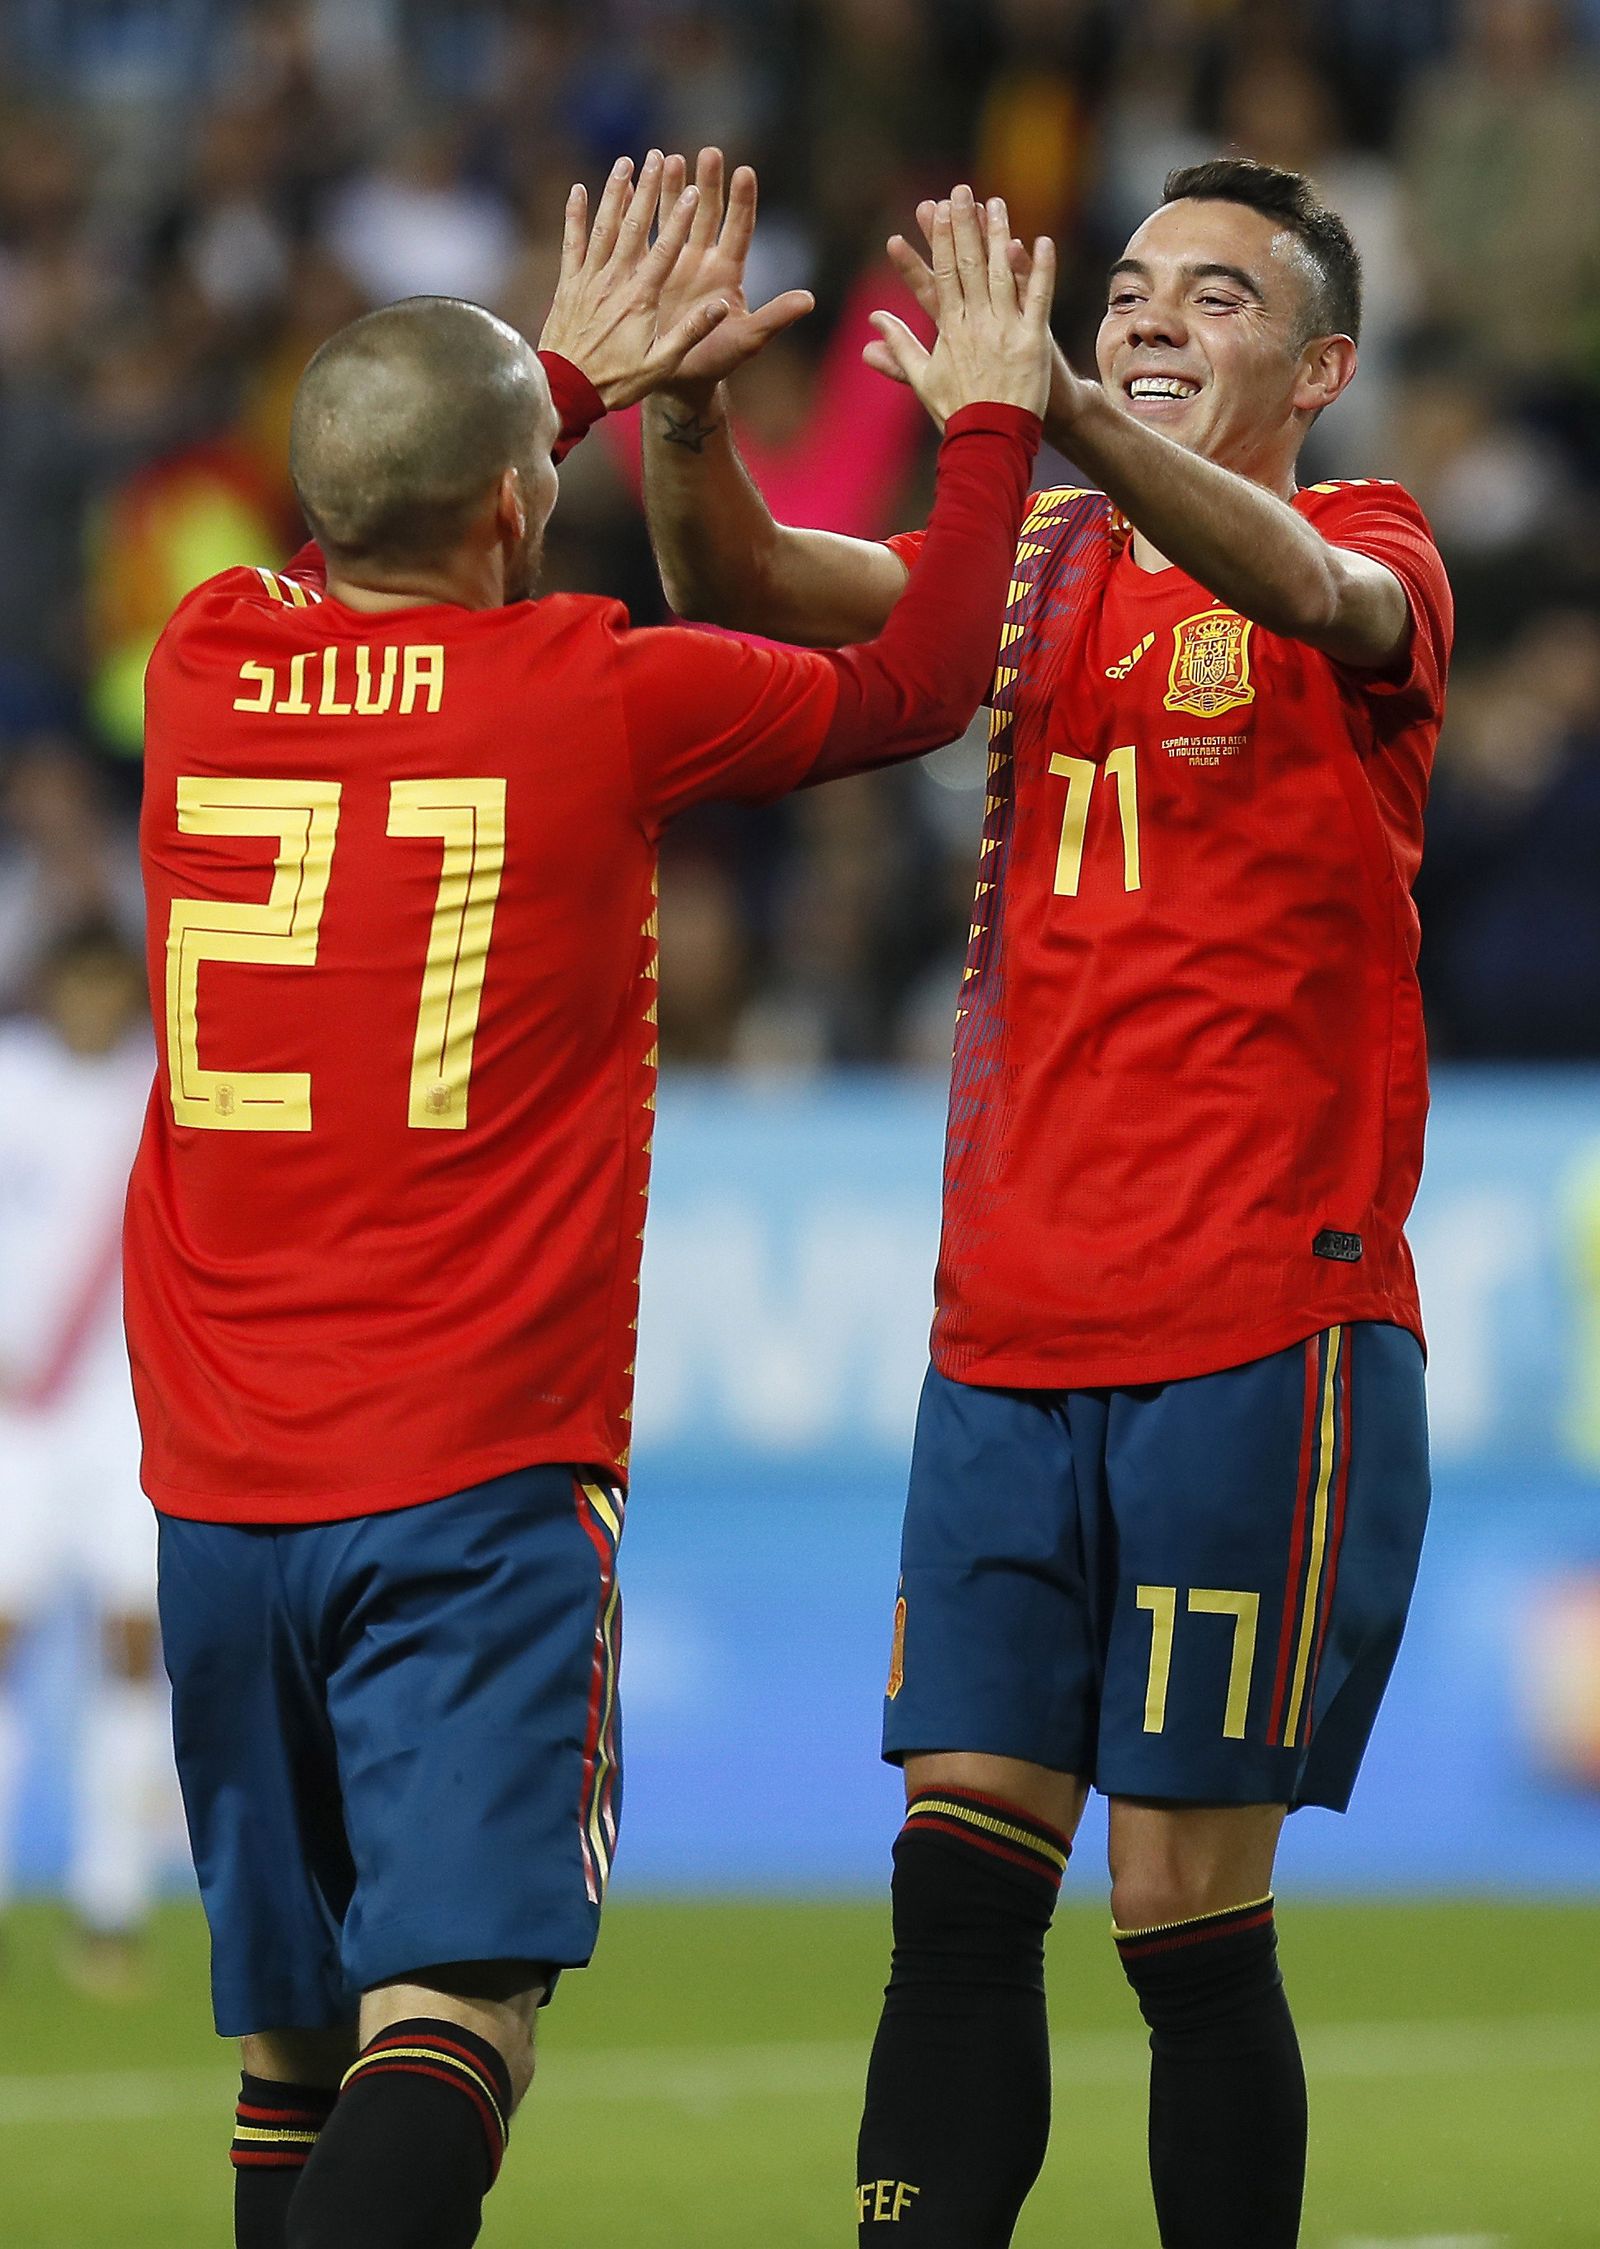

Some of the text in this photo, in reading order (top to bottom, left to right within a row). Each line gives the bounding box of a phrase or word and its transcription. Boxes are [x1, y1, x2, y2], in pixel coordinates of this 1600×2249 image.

[233, 644, 445, 715] SILVA
[1161, 736, 1189, 749] ESPAÑA
[1202, 736, 1226, 746] COSTA
[1228, 736, 1247, 745] RICA
[1168, 749, 1175, 758] 11
[1176, 746, 1220, 757] NOVIEMBRE
[1188, 756, 1220, 766] MÁLAGA
[166, 776, 507, 1132] 21
[1136, 1585, 1260, 1740] 17
[855, 2179, 921, 2223] FEF
